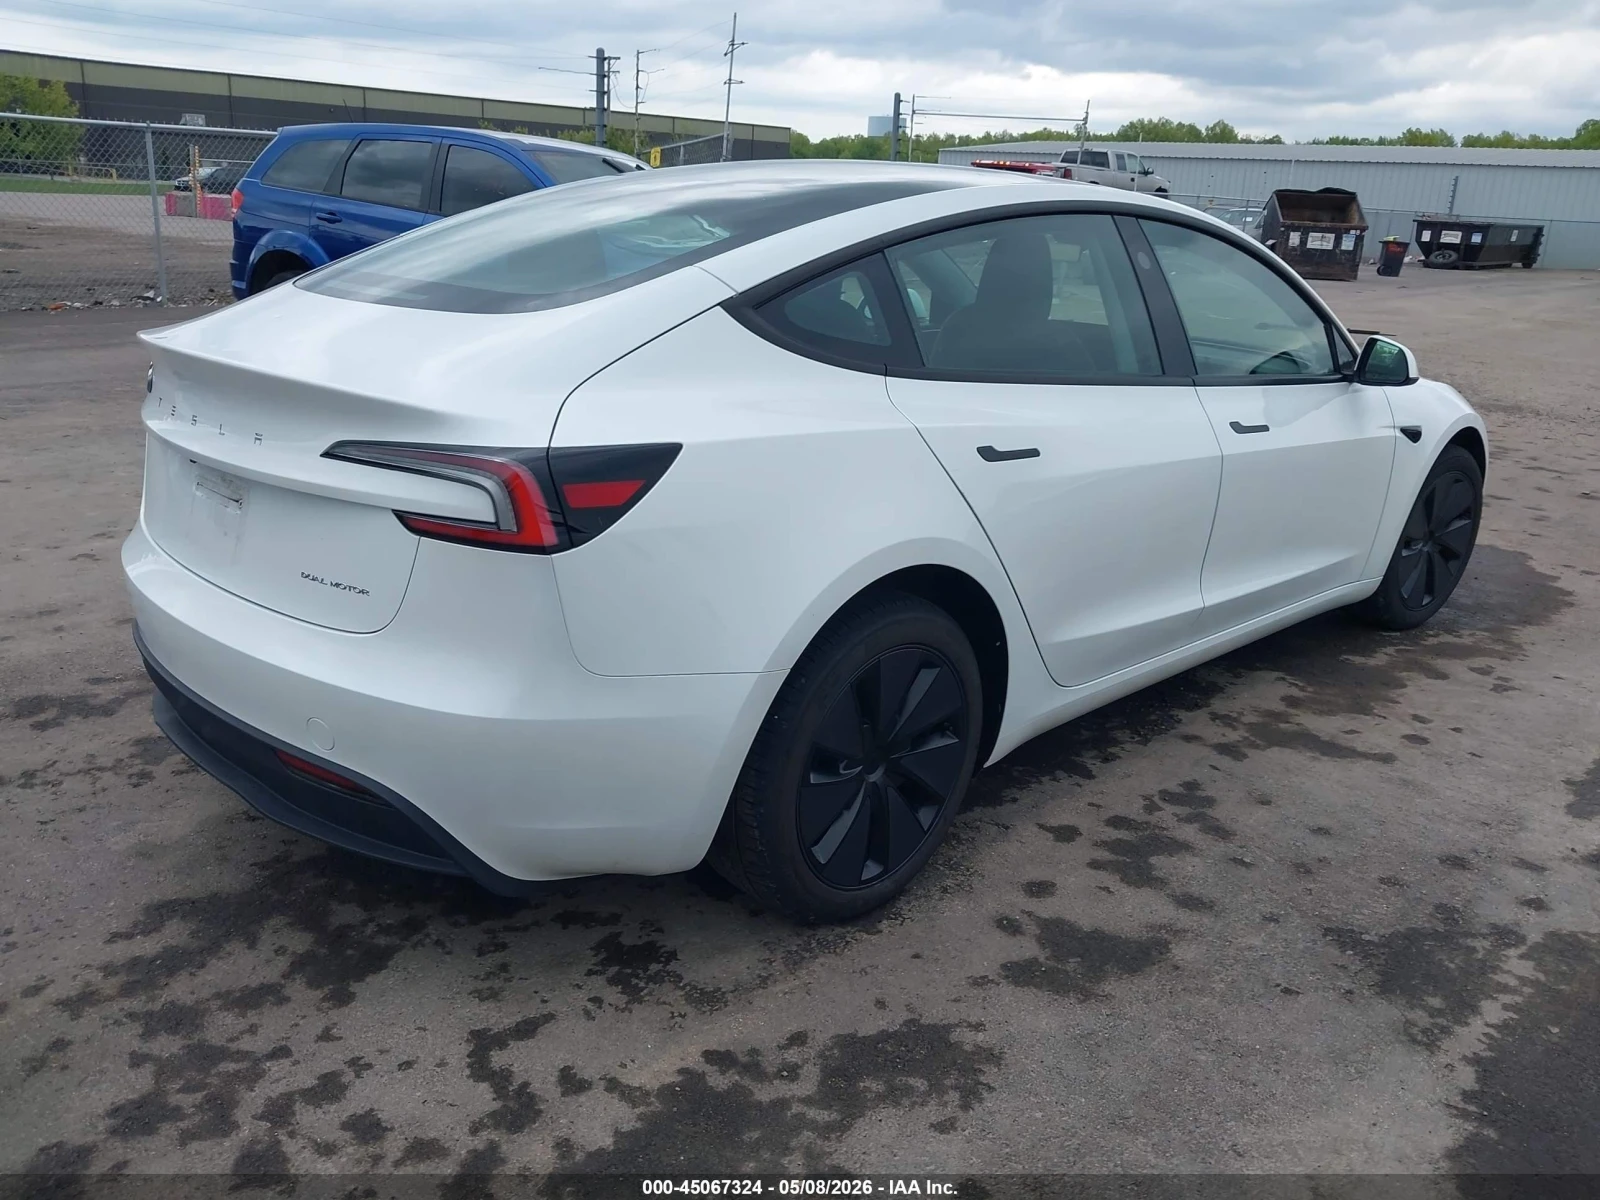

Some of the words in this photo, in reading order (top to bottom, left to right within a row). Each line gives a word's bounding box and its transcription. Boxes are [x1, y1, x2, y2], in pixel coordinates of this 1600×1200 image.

[158, 396, 264, 446] TESLA
[300, 571, 328, 586] DUAL
[329, 580, 370, 597] MOTOR
